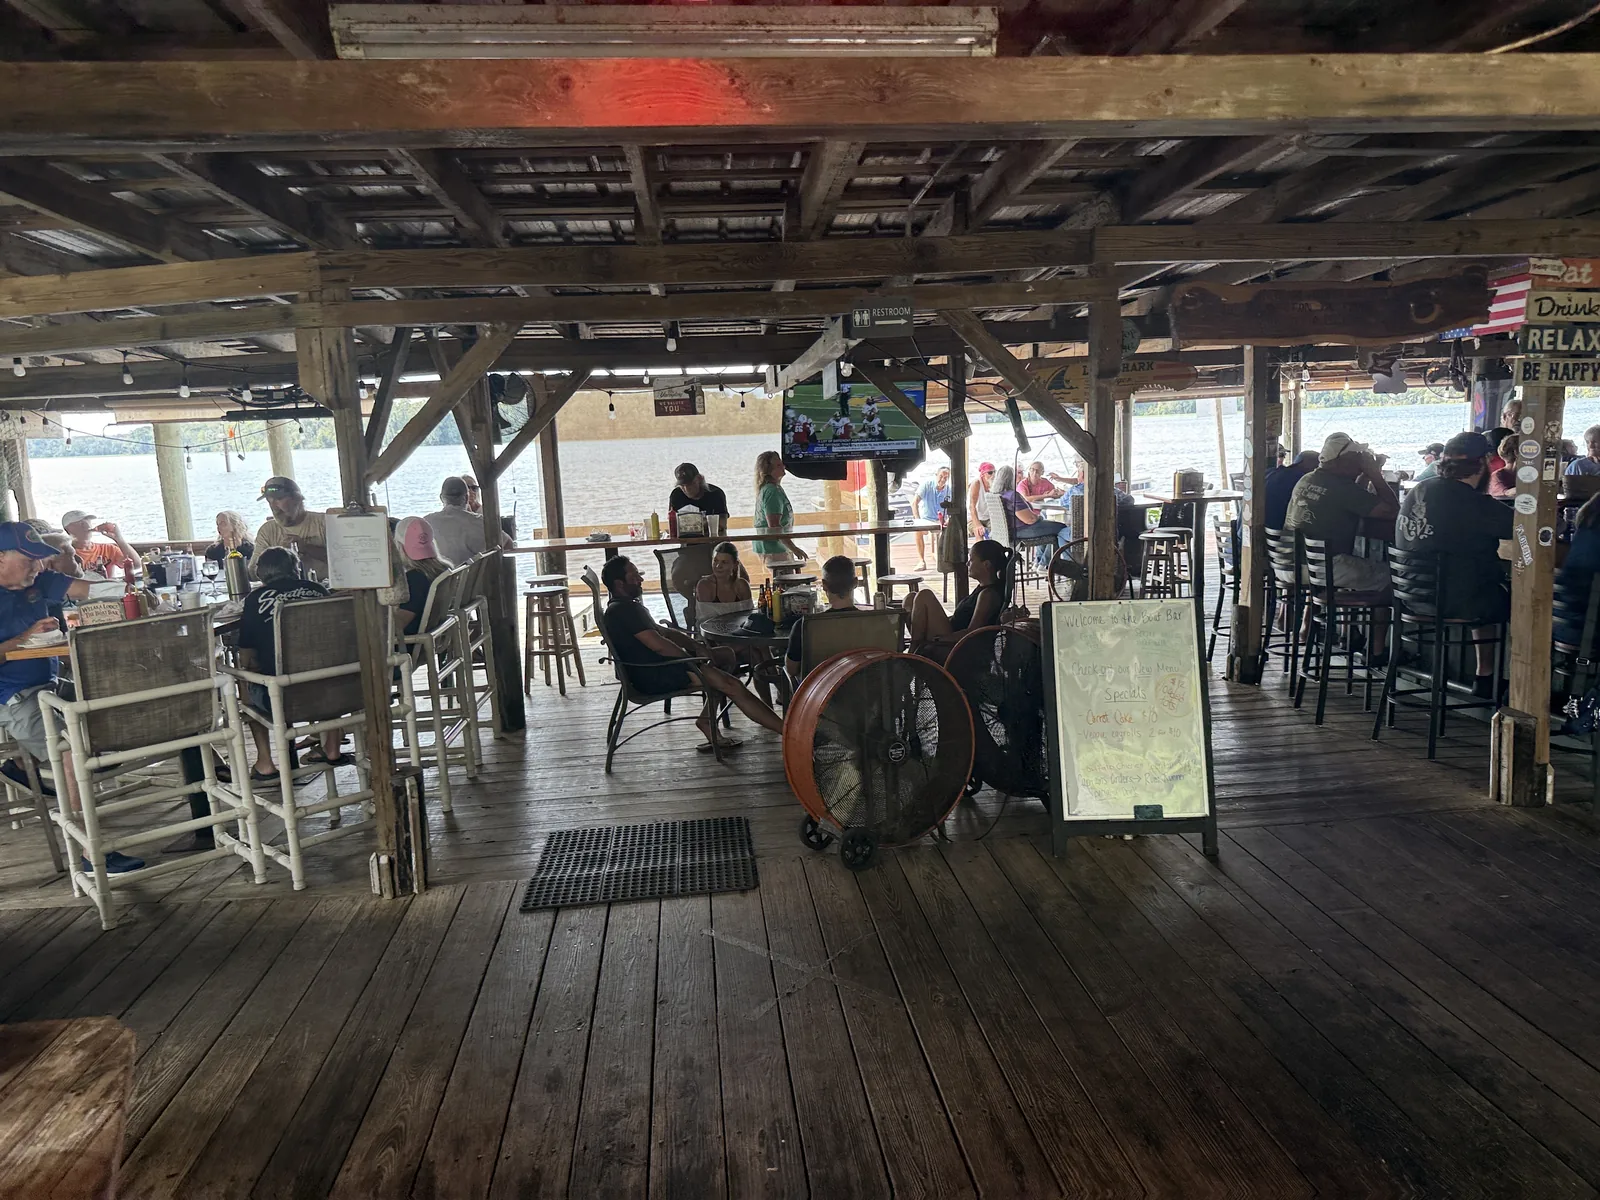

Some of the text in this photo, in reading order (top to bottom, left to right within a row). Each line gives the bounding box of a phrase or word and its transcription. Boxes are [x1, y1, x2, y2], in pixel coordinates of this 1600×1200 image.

[872, 306, 911, 317] RESTROOM
[1535, 296, 1600, 317] Drink
[1527, 328, 1600, 351] RELAX
[1522, 362, 1600, 381] BE HAPPY
[664, 405, 681, 413] YOU
[1064, 613, 1105, 628] Welcome
[1109, 615, 1119, 625] to
[1122, 611, 1137, 625] the
[1166, 609, 1182, 622] Bar
[1071, 661, 1100, 676] Check
[1117, 664, 1130, 674] our
[1134, 662, 1153, 674] New
[1104, 686, 1147, 702] Specials
[1086, 709, 1110, 725] Carrot
[1114, 709, 1134, 725] Cake
[1148, 728, 1156, 738] 2
[1168, 727, 1182, 738] $10
